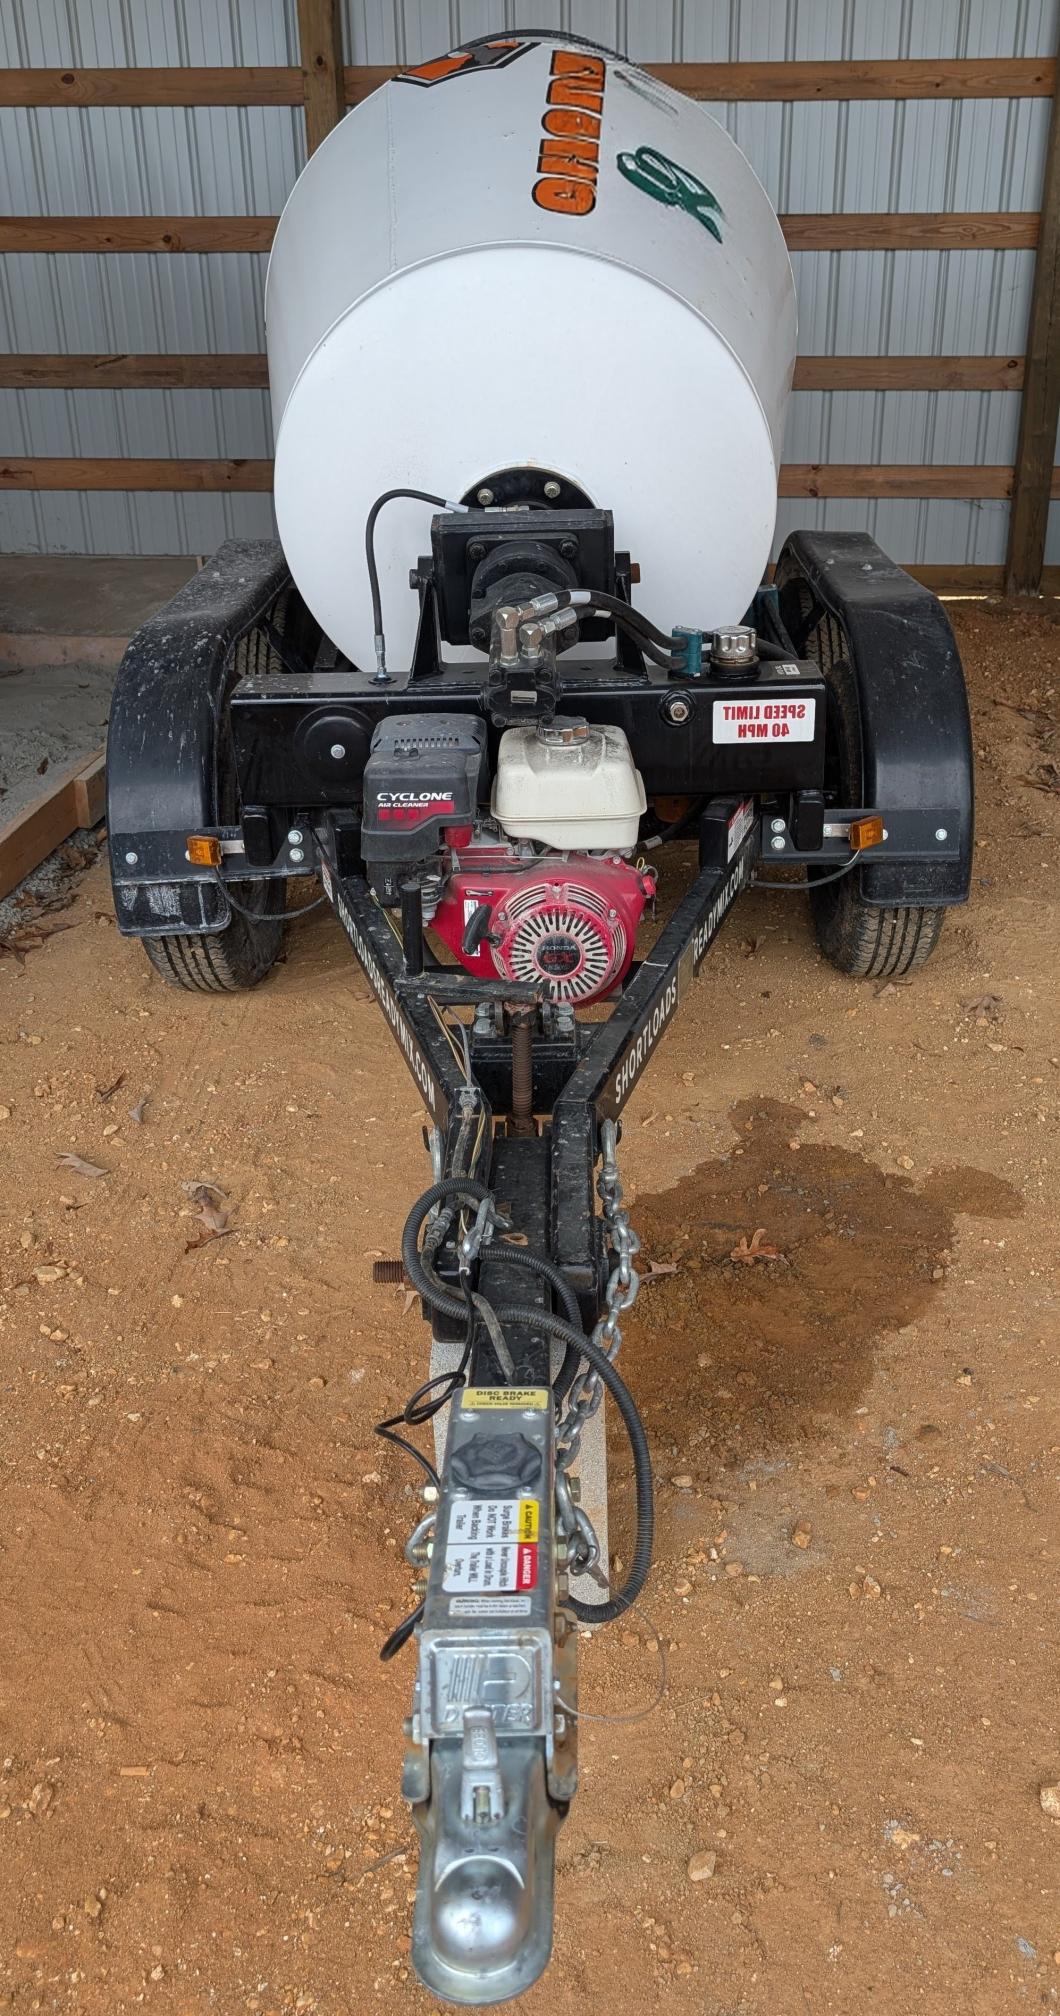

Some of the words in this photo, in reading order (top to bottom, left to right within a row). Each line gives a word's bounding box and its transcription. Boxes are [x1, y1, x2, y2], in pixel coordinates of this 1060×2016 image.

[377, 792, 453, 801] CYCLONE
[615, 976, 677, 1104] SHORTLOADS
[693, 856, 745, 960] READYMIX.COM
[472, 1505, 483, 1518] When
[487, 1513, 496, 1524] NOT
[500, 1505, 513, 1519] Surge
[456, 1514, 466, 1530] Trailer
[467, 1520, 481, 1540] Backing
[501, 1521, 512, 1538] Brakes
[525, 1511, 533, 1539] CAUTION
[485, 1525, 496, 1538] Work
[522, 1555, 531, 1584] DANGER
[445, 1703, 533, 1722] DTER
